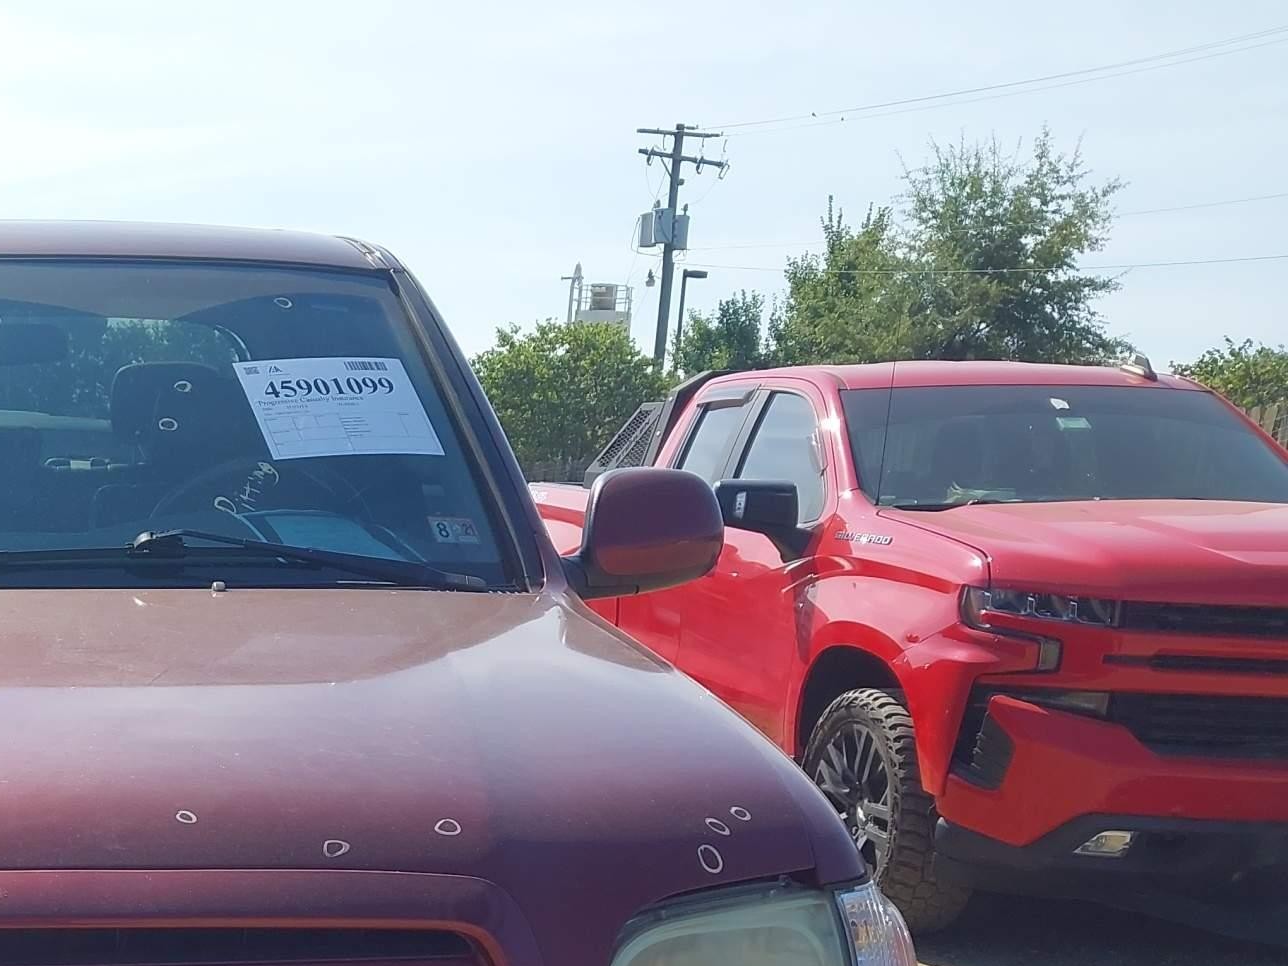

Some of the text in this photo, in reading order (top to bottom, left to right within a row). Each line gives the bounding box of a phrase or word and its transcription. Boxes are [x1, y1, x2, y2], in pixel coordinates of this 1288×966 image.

[265, 377, 394, 398] 45901099
[437, 522, 450, 538] 8
[834, 530, 894, 545] SILVERADO
